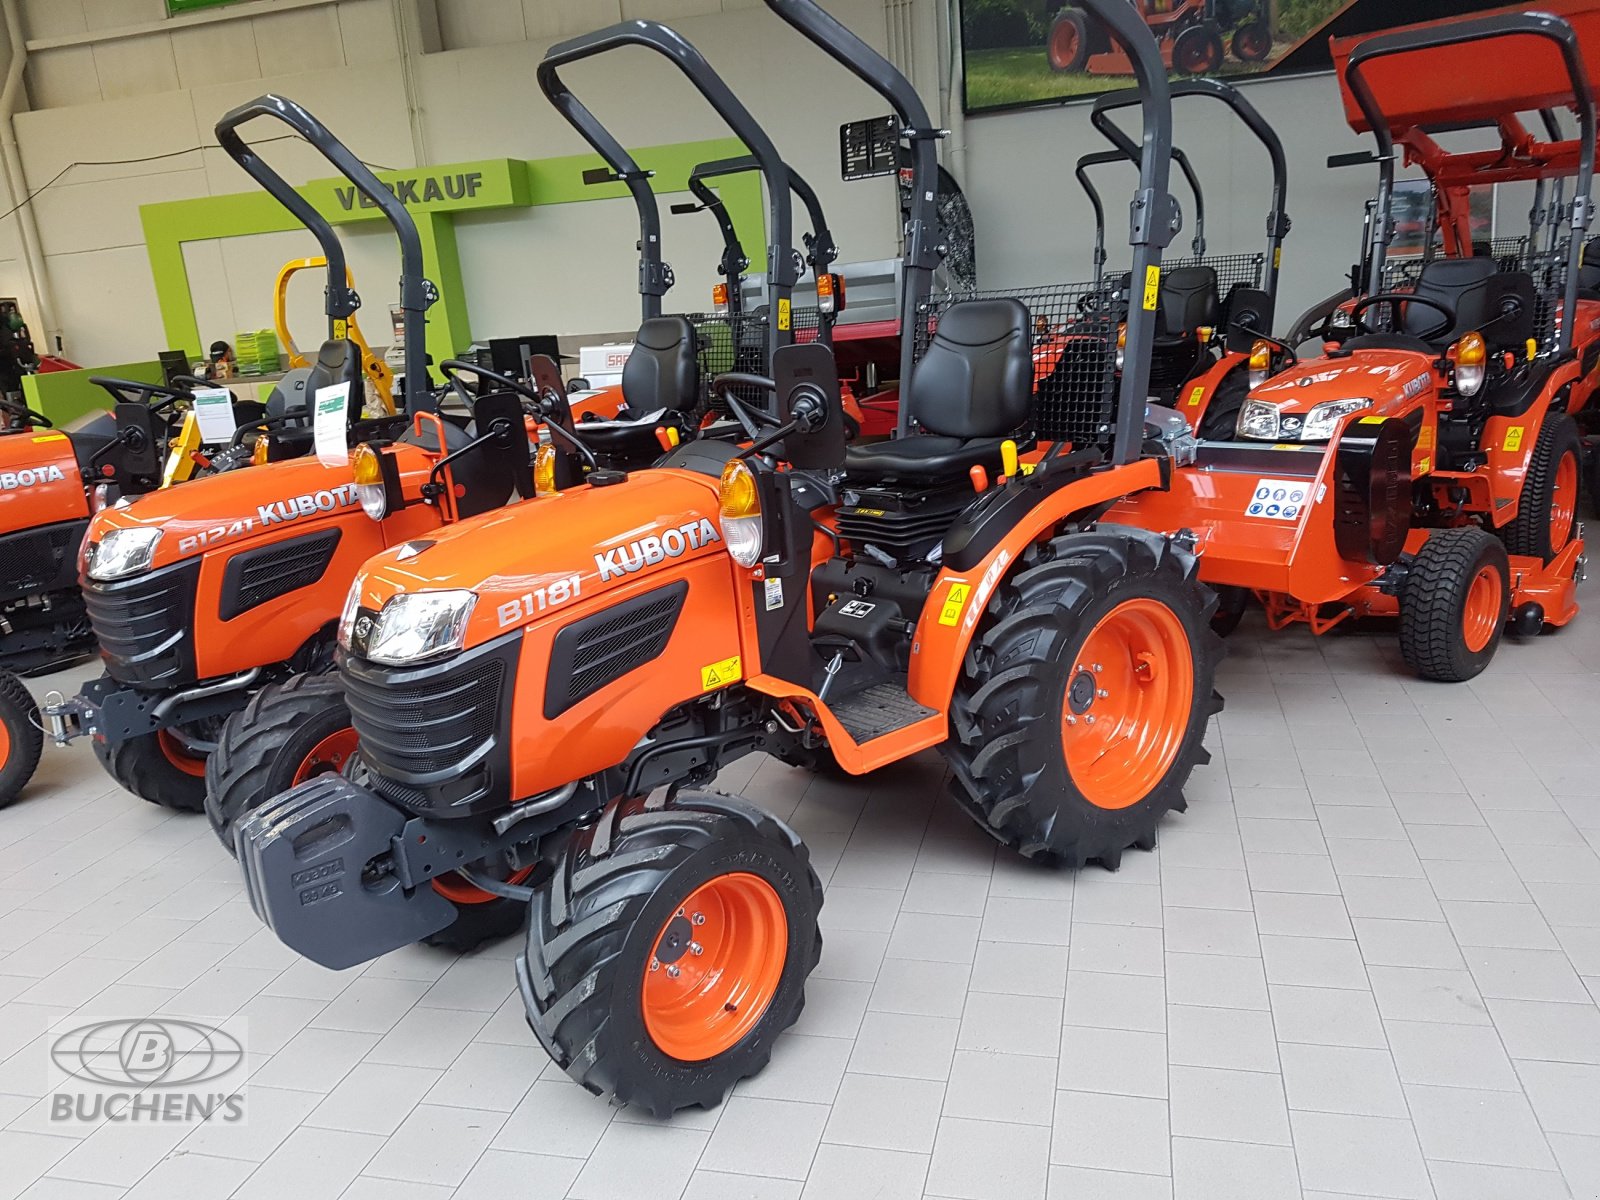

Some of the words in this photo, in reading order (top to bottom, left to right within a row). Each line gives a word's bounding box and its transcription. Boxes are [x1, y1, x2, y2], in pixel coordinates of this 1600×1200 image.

[0, 464, 65, 490] BOTA
[178, 517, 253, 554] B1241
[496, 574, 582, 628] B1181
[593, 516, 721, 582] KUBOTA
